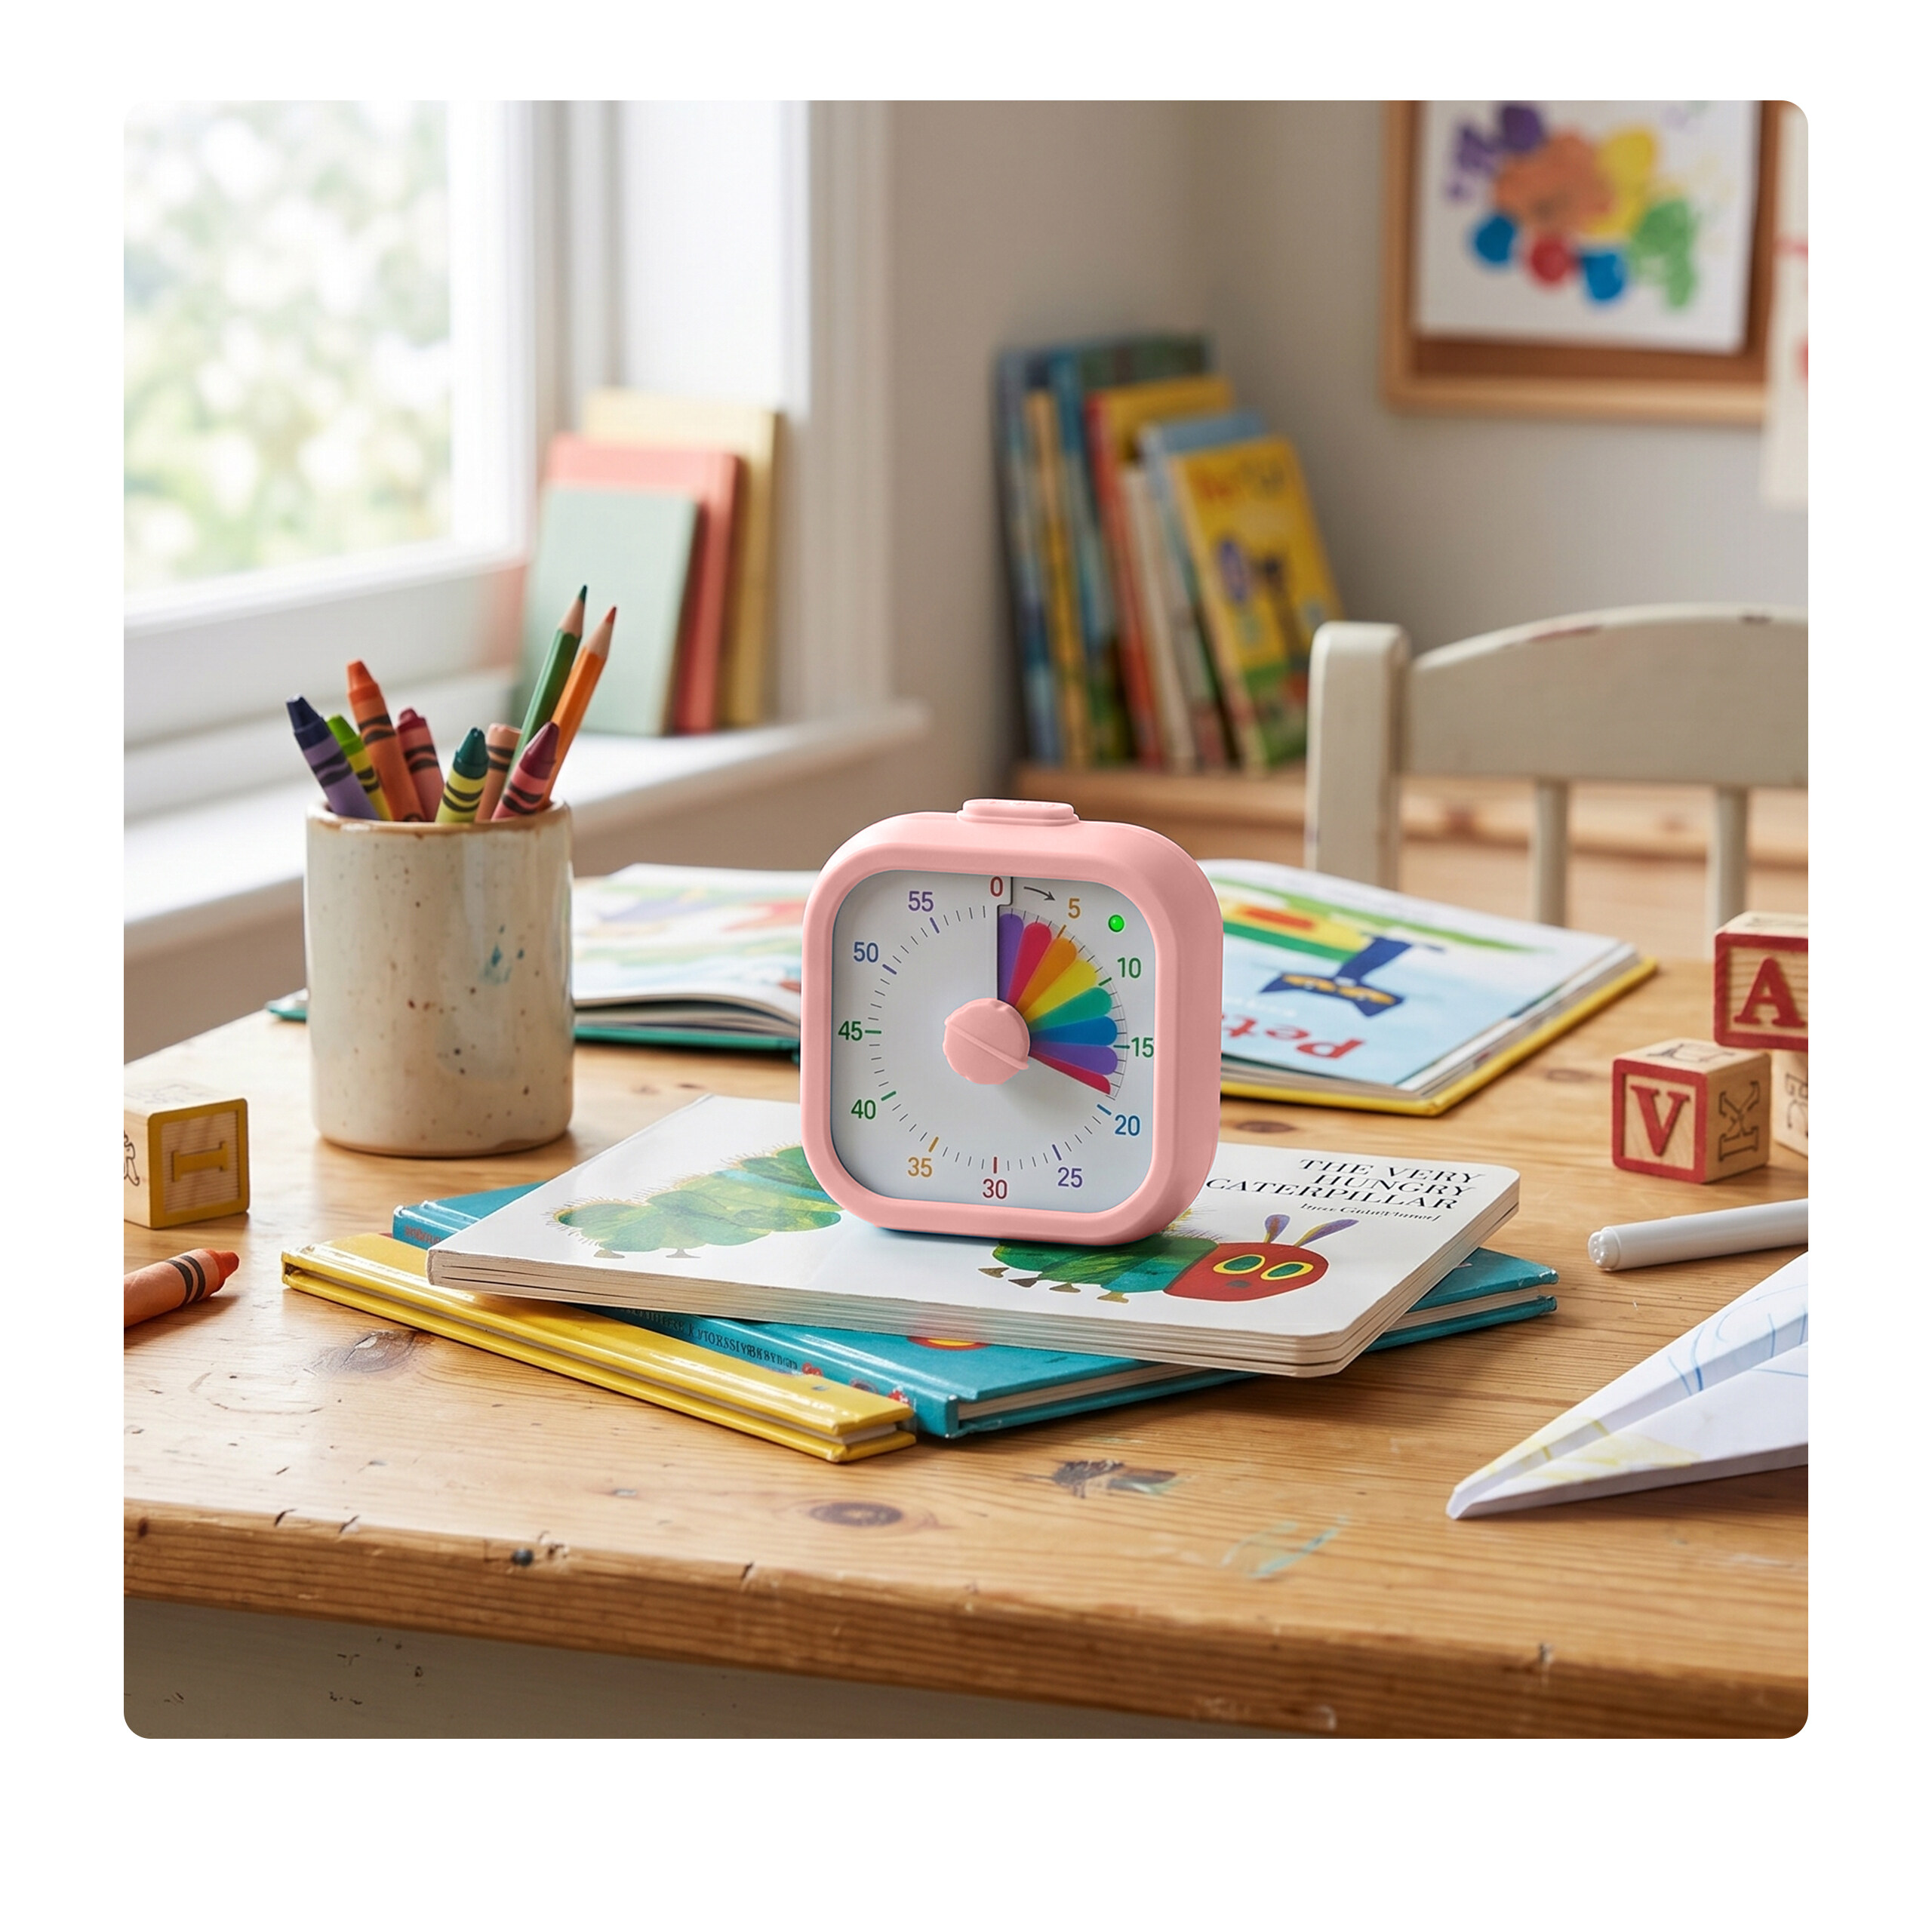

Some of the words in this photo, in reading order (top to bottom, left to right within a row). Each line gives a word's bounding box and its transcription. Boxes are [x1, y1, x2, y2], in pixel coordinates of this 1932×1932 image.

[989, 876, 1004, 897] 0
[907, 891, 934, 912] 55
[1067, 897, 1081, 919] 5
[853, 941, 879, 963] 50
[1117, 957, 1142, 979] 10
[1733, 956, 1807, 1028] A
[837, 1020, 863, 1041] 45
[1222, 1014, 1364, 1059] Pet
[1131, 1037, 1155, 1058] 15
[851, 1099, 877, 1121] 40
[1630, 1084, 1691, 1158] V
[1114, 1115, 1141, 1137] 20
[907, 1157, 934, 1178] 35
[1057, 1167, 1084, 1189] 25
[1299, 1158, 1374, 1176] THE
[1387, 1166, 1486, 1184] VERY
[982, 1179, 1008, 1200] 30
[1205, 1178, 1460, 1210] CATERPILLAR
[1312, 1174, 1477, 1198] HUNGRY
